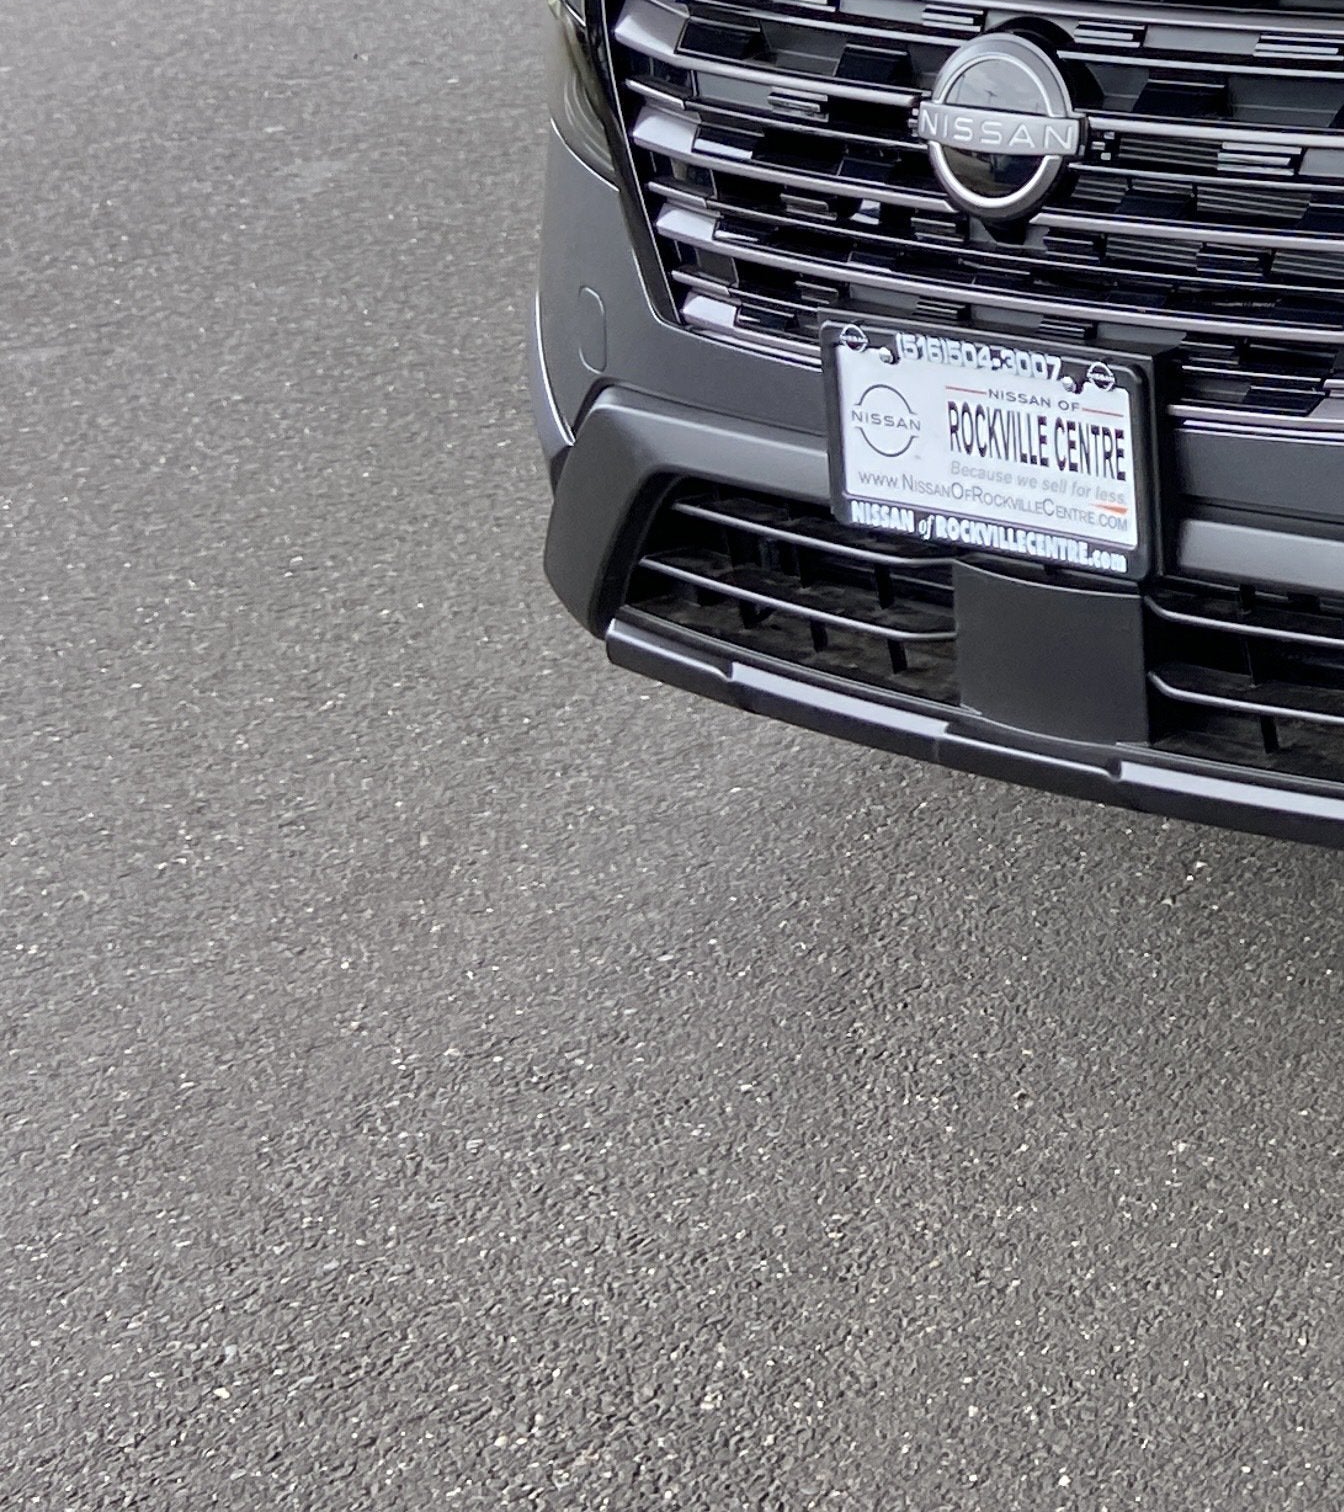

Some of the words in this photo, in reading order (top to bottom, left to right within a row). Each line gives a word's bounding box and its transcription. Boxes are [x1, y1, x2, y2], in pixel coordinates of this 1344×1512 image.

[920, 108, 1073, 150] NISSAN
[851, 409, 921, 431] NISSAN
[988, 388, 1051, 408] NISSAN
[1057, 399, 1081, 413] OF
[947, 400, 1051, 468] ROCKVILLE
[1054, 415, 1127, 482] CENTRE
[950, 460, 1014, 486] Because
[1016, 474, 1038, 489] we
[1042, 478, 1068, 494] sell
[1071, 481, 1092, 498] for
[850, 499, 915, 533] NISSAN
[918, 514, 935, 541] of
[934, 514, 1128, 573] ROCKVILLECENTRE.com
